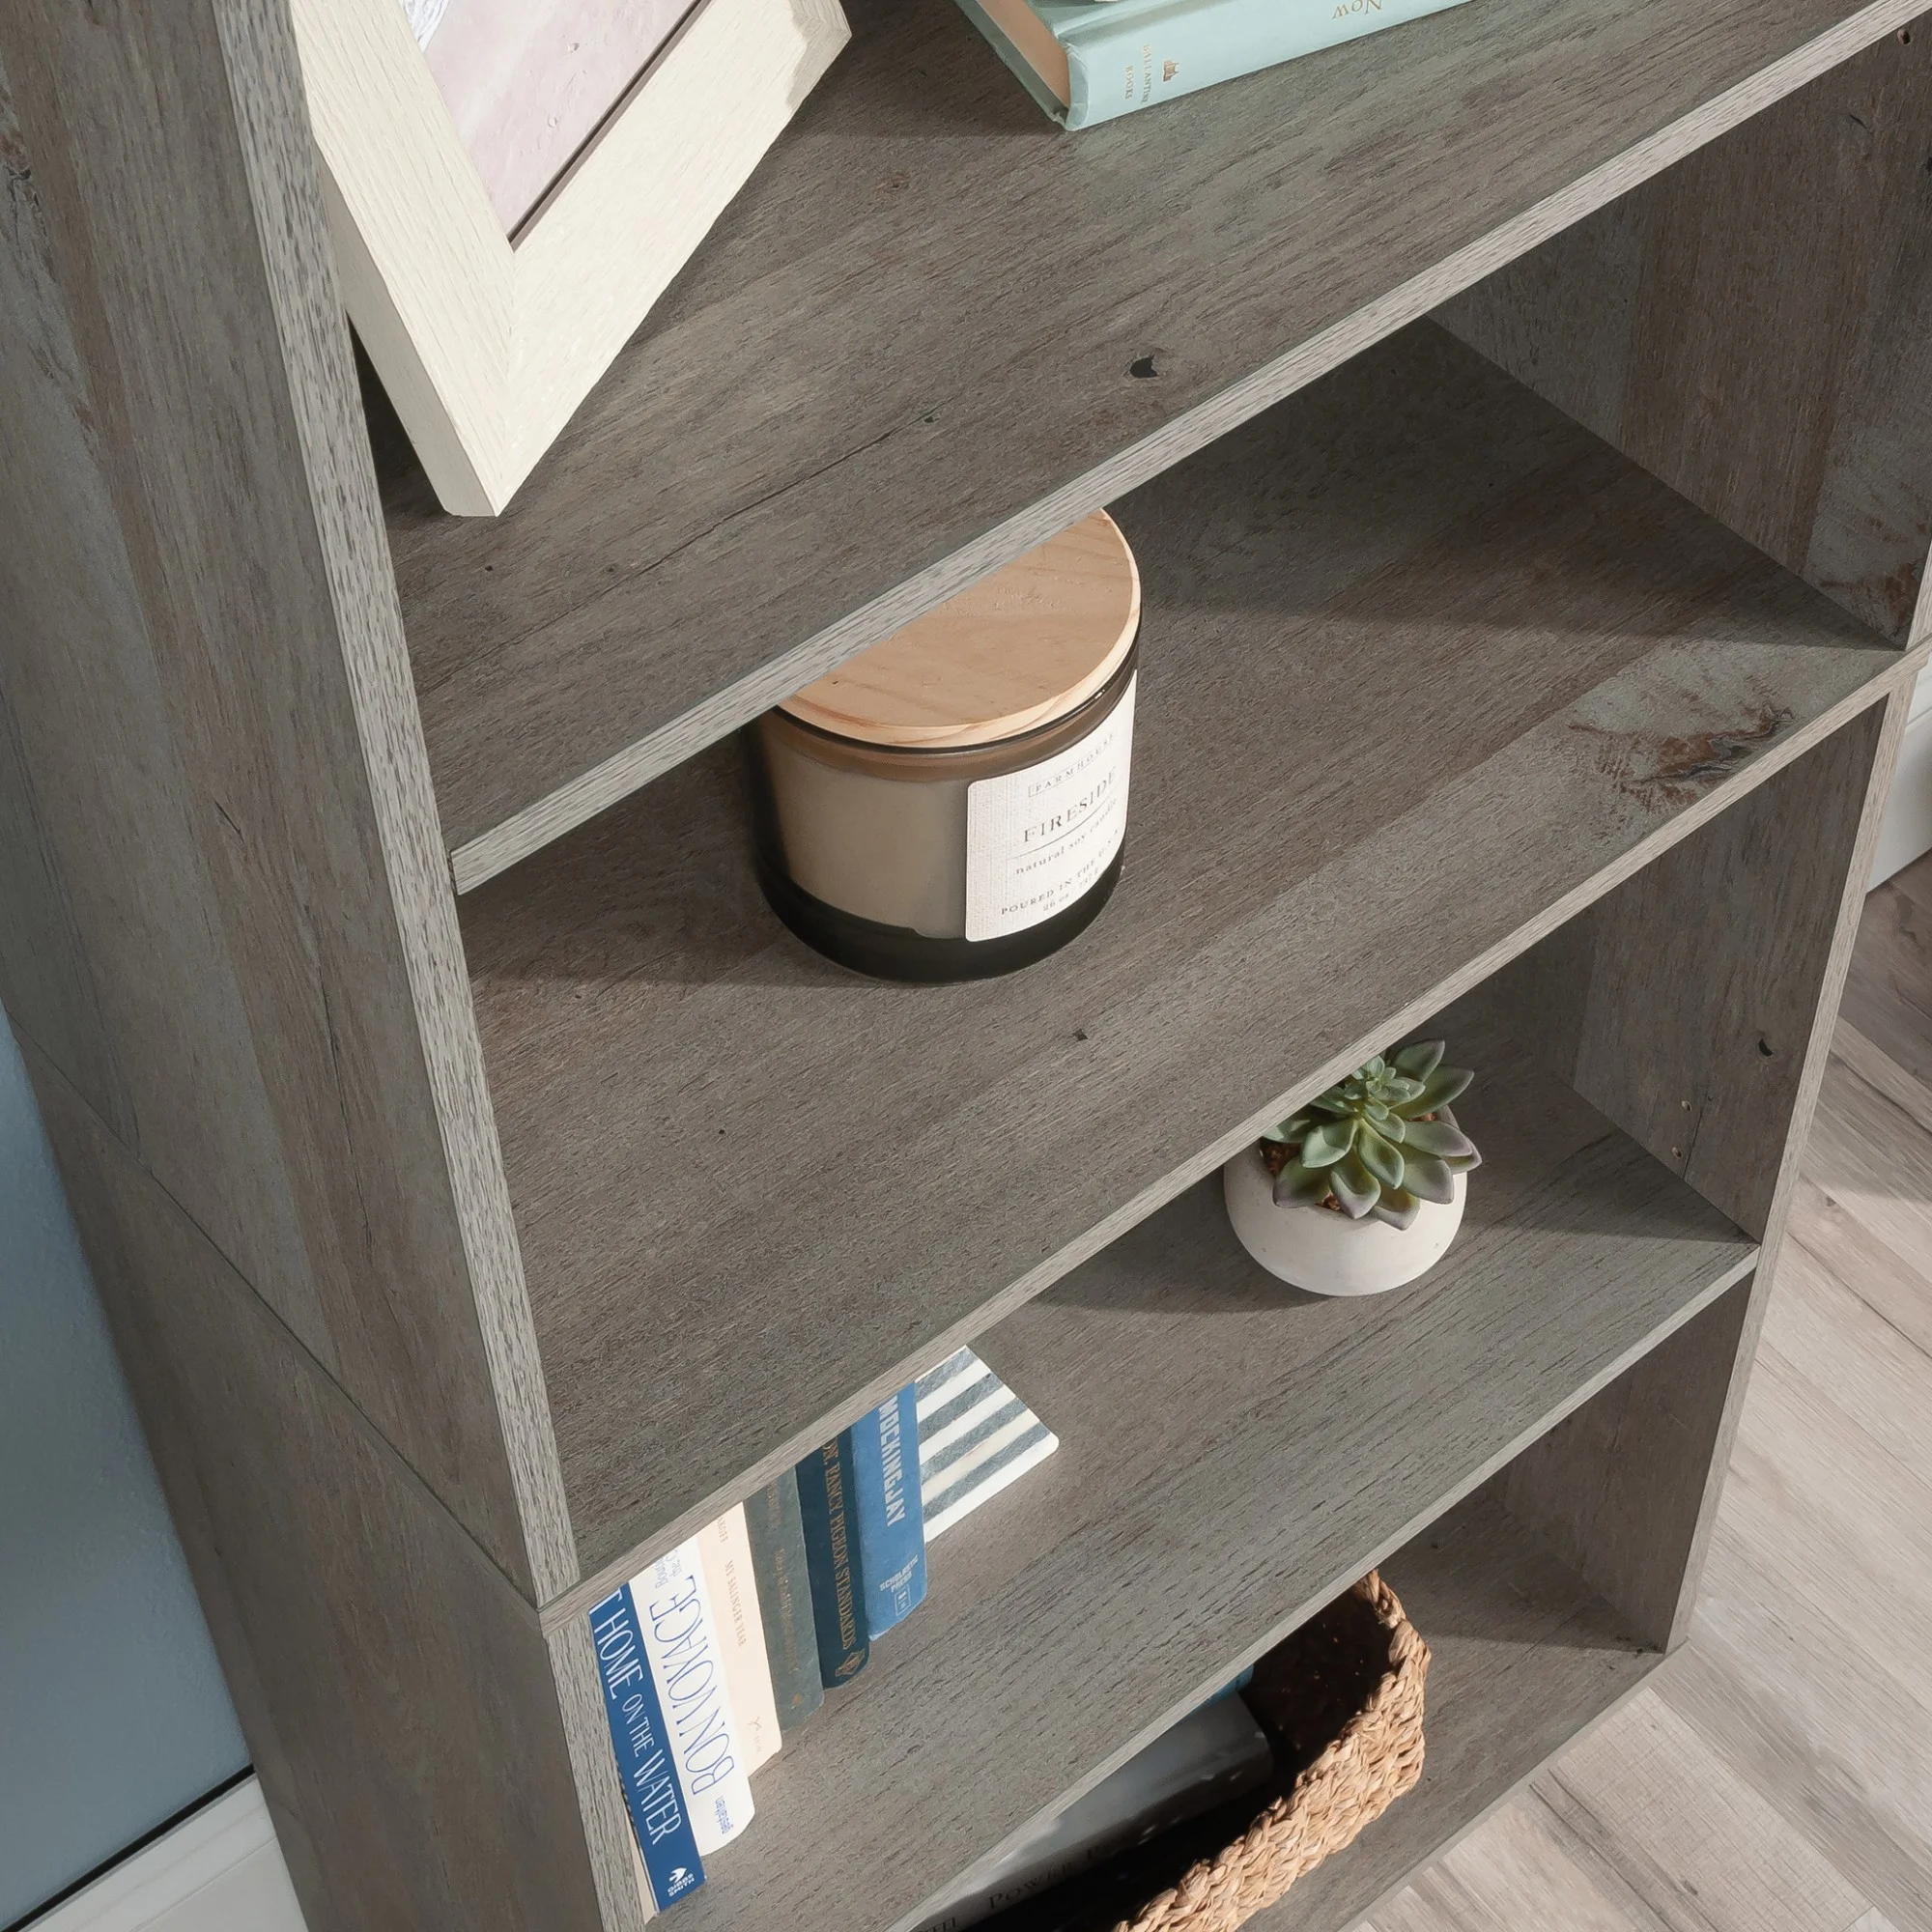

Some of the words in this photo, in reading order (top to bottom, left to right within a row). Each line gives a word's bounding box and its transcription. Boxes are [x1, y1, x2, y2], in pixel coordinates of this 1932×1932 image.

[1024, 765, 1117, 842] FIRESIDE
[1015, 845, 1065, 875] natural
[1068, 832, 1087, 851] soy
[1001, 890, 1055, 916] POURED
[1059, 878, 1072, 892] IN
[879, 1394, 906, 1527] MOCKINGJAY
[830, 1511, 849, 1570] PIGEON
[835, 1566, 857, 1651] STANDARDS
[594, 1607, 643, 1700] HOME
[649, 1575, 718, 1726] VOYAGE
[622, 1693, 645, 1724] ON
[629, 1717, 655, 1758] THE
[634, 1748, 682, 1846] WATER
[714, 1794, 734, 1834] gestalten
